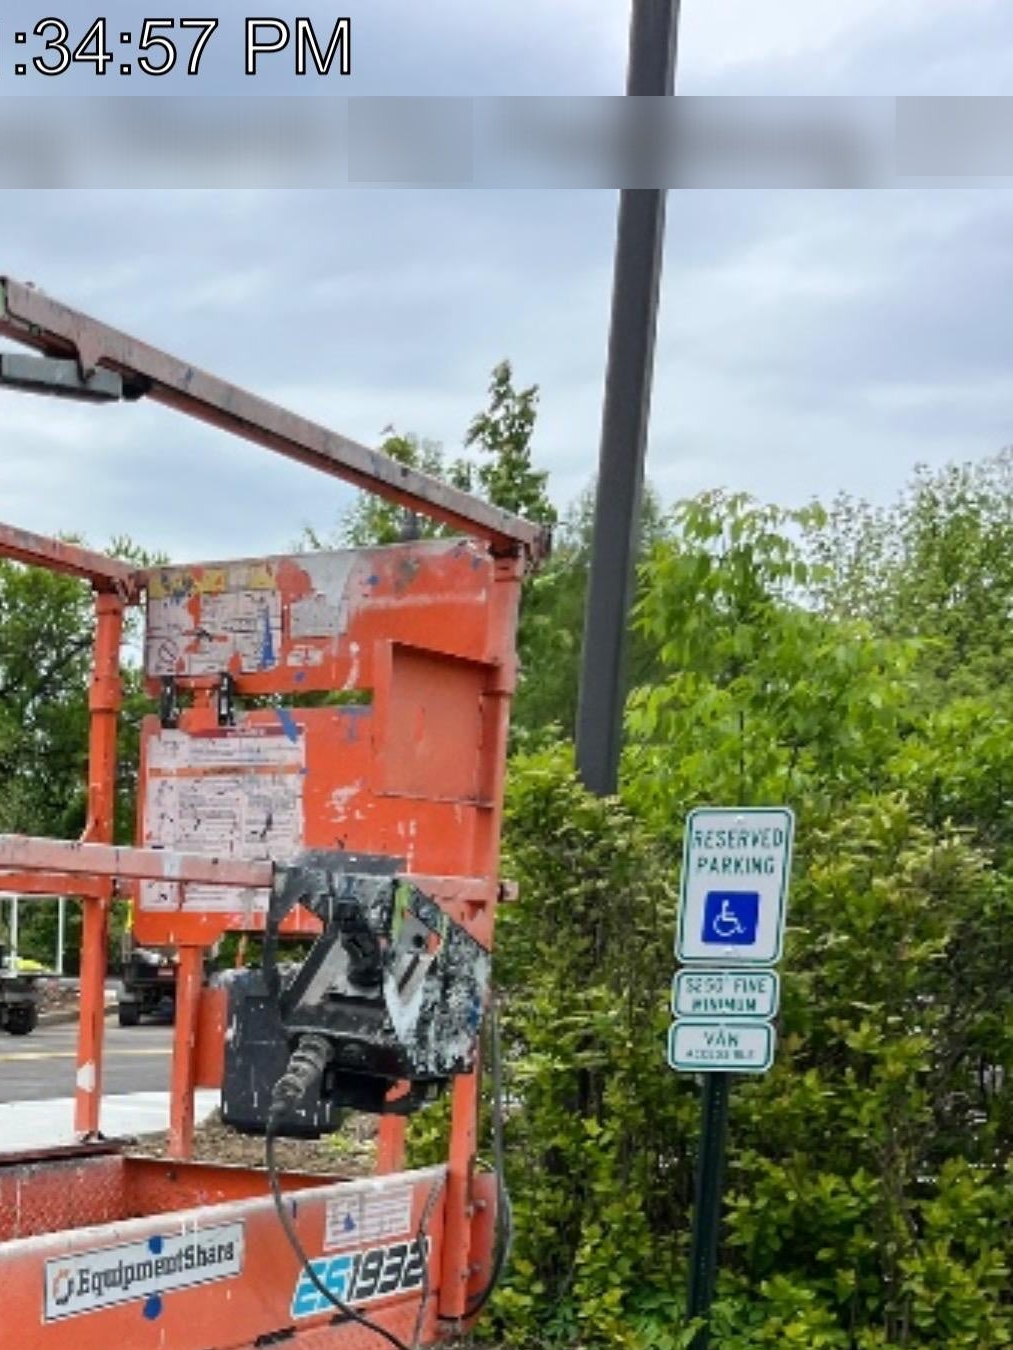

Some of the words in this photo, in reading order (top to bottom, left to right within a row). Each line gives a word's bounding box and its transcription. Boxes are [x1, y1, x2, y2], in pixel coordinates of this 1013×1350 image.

[692, 827, 784, 849] RESERVED
[696, 855, 775, 875] PARKING
[733, 977, 768, 994] FINE
[703, 1029, 740, 1047] VAN
[77, 1241, 235, 1297] EquipmentShare
